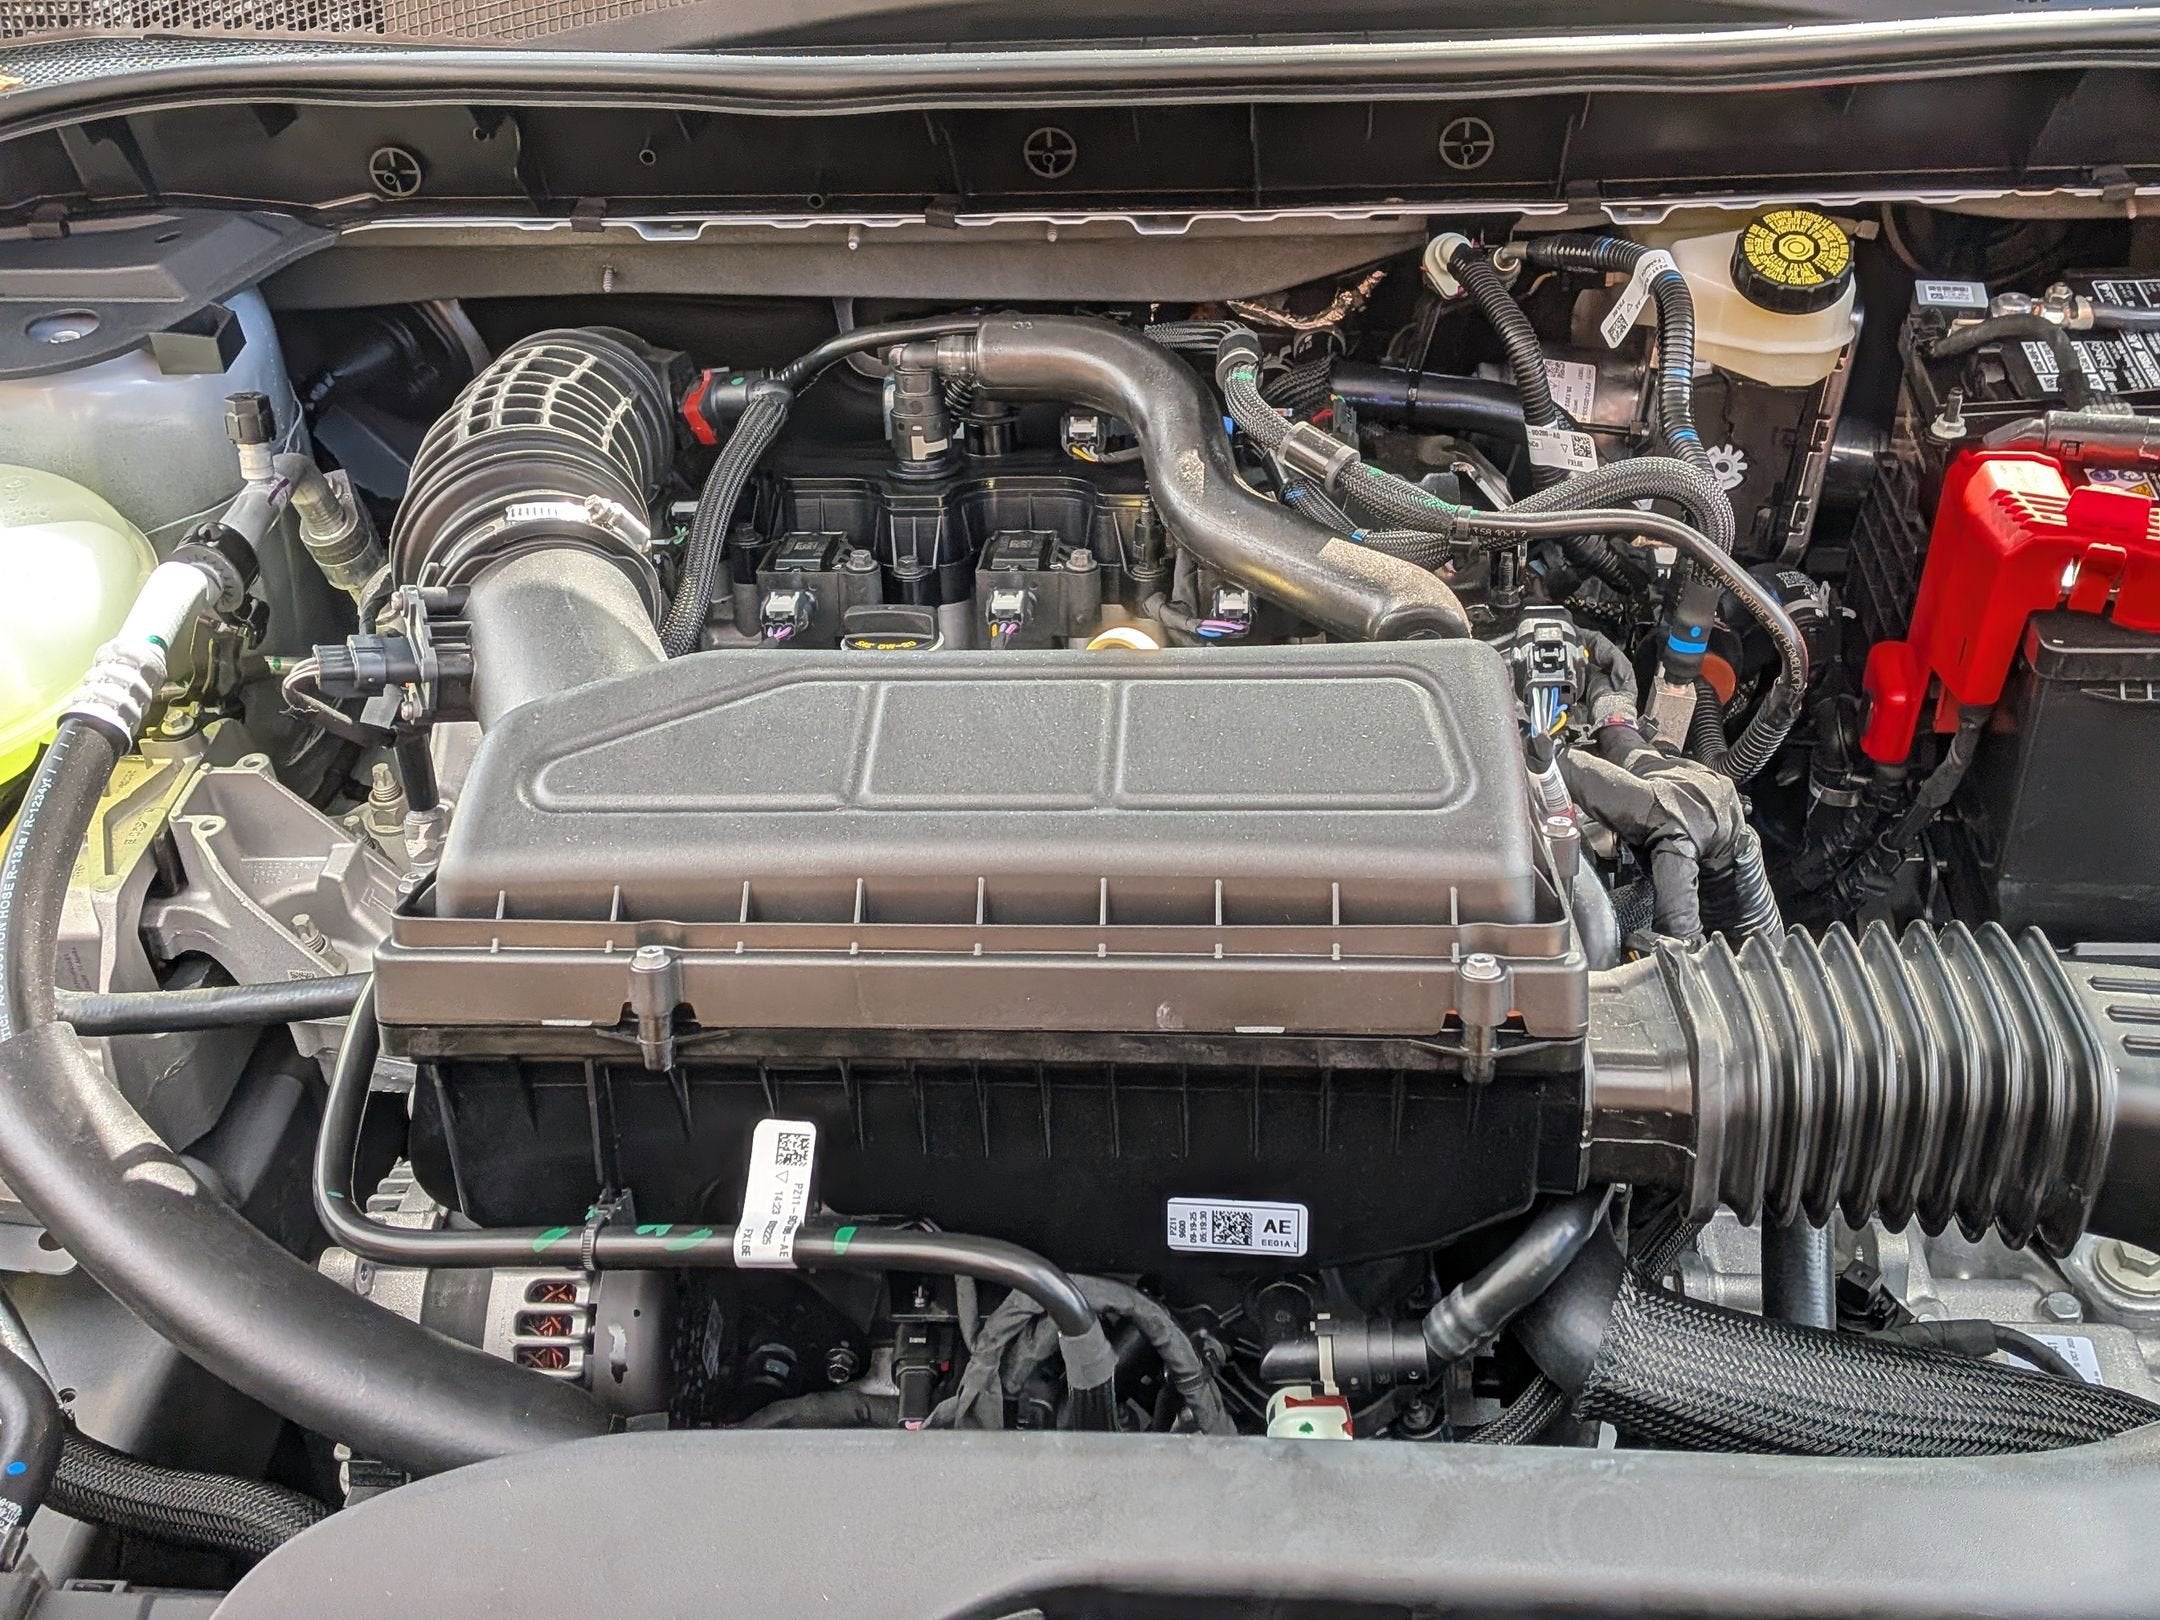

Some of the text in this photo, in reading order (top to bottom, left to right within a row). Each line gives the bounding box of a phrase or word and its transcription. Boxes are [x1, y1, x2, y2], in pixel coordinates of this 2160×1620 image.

[6, 837, 28, 879] R-134a
[0, 882, 15, 919] HOSE
[1263, 1219, 1292, 1234] AE
[1262, 1239, 1291, 1248] EE01A
